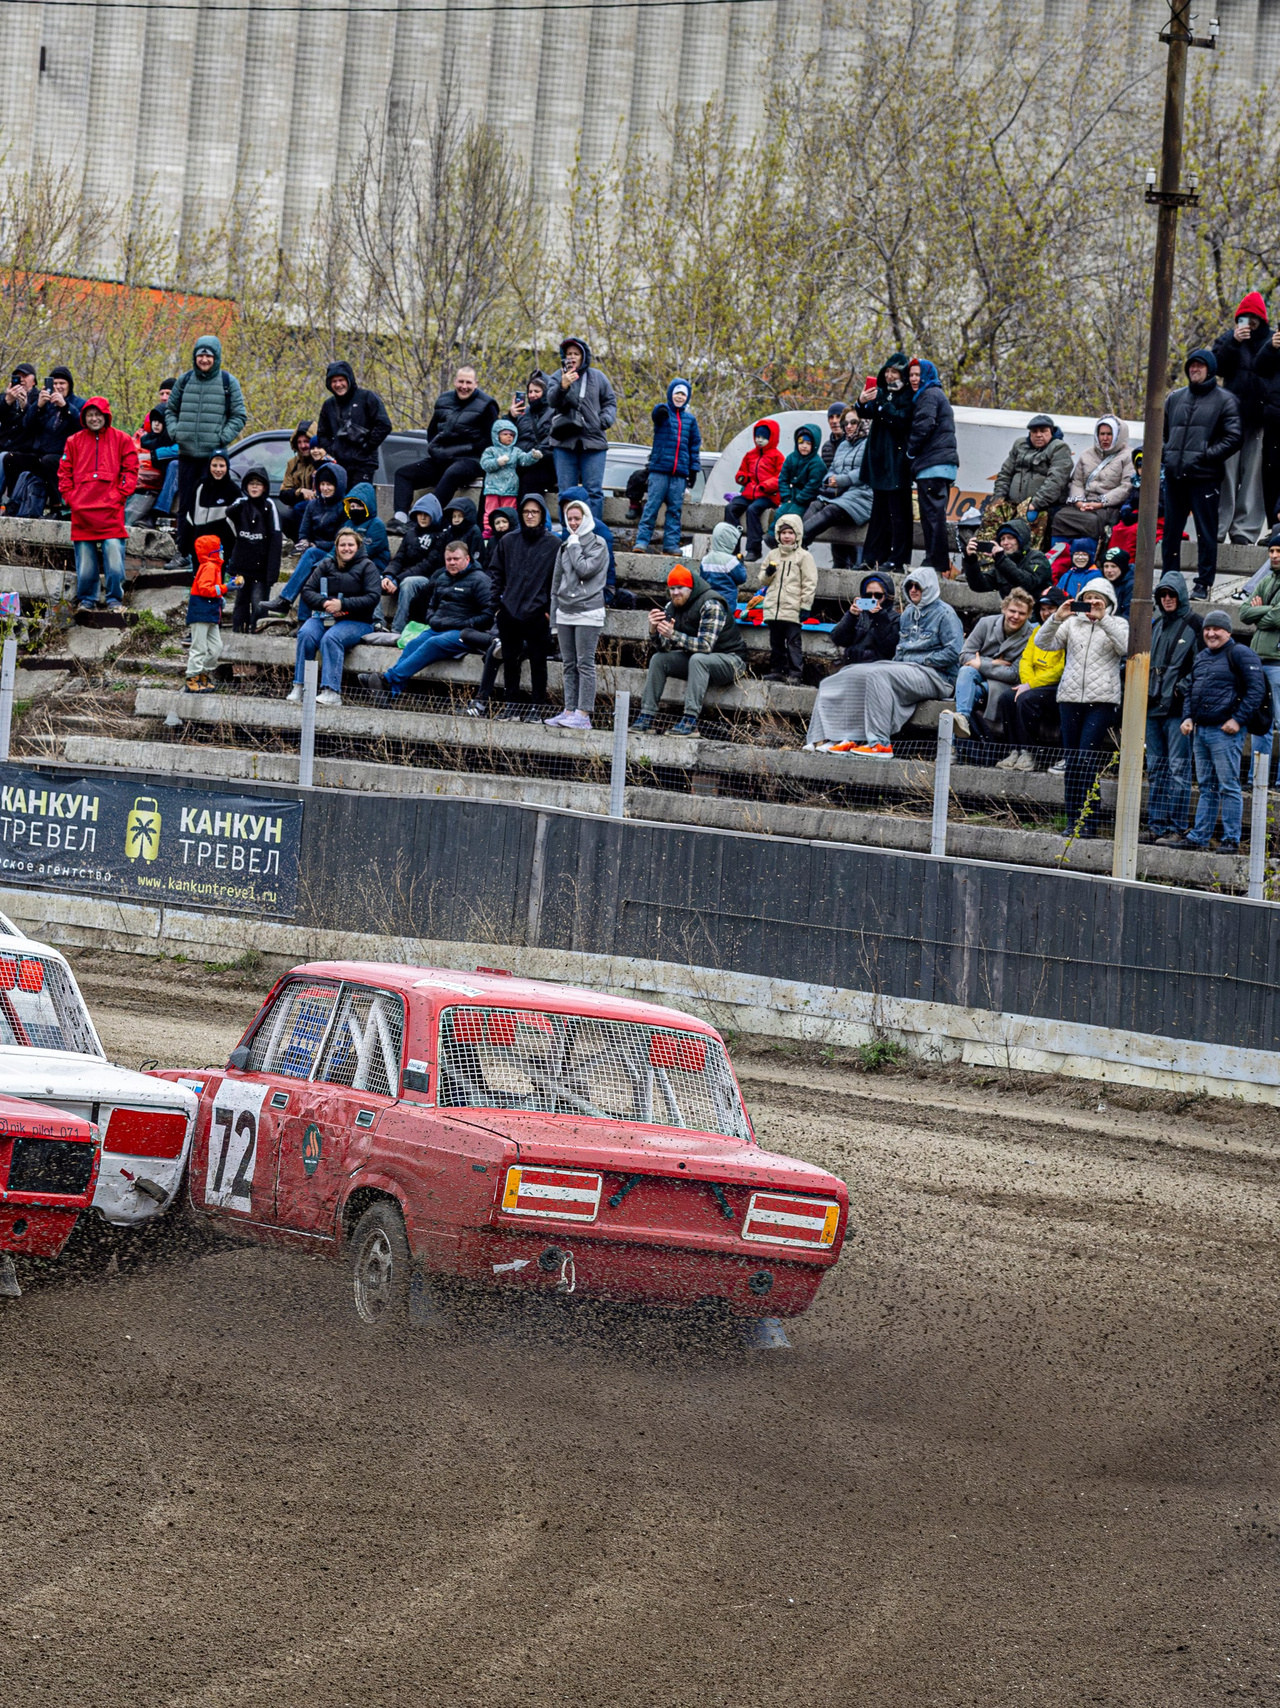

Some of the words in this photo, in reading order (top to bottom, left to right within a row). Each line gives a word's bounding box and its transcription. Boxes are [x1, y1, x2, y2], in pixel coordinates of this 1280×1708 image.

[0, 785, 100, 822] КАНКУН
[0, 816, 96, 853] ТРЕВЕЛ
[179, 807, 283, 844] КАНКУН
[38, 863, 111, 882] агентство
[179, 838, 280, 876] ТРЕВЕЛ
[213, 1107, 256, 1199] 72
